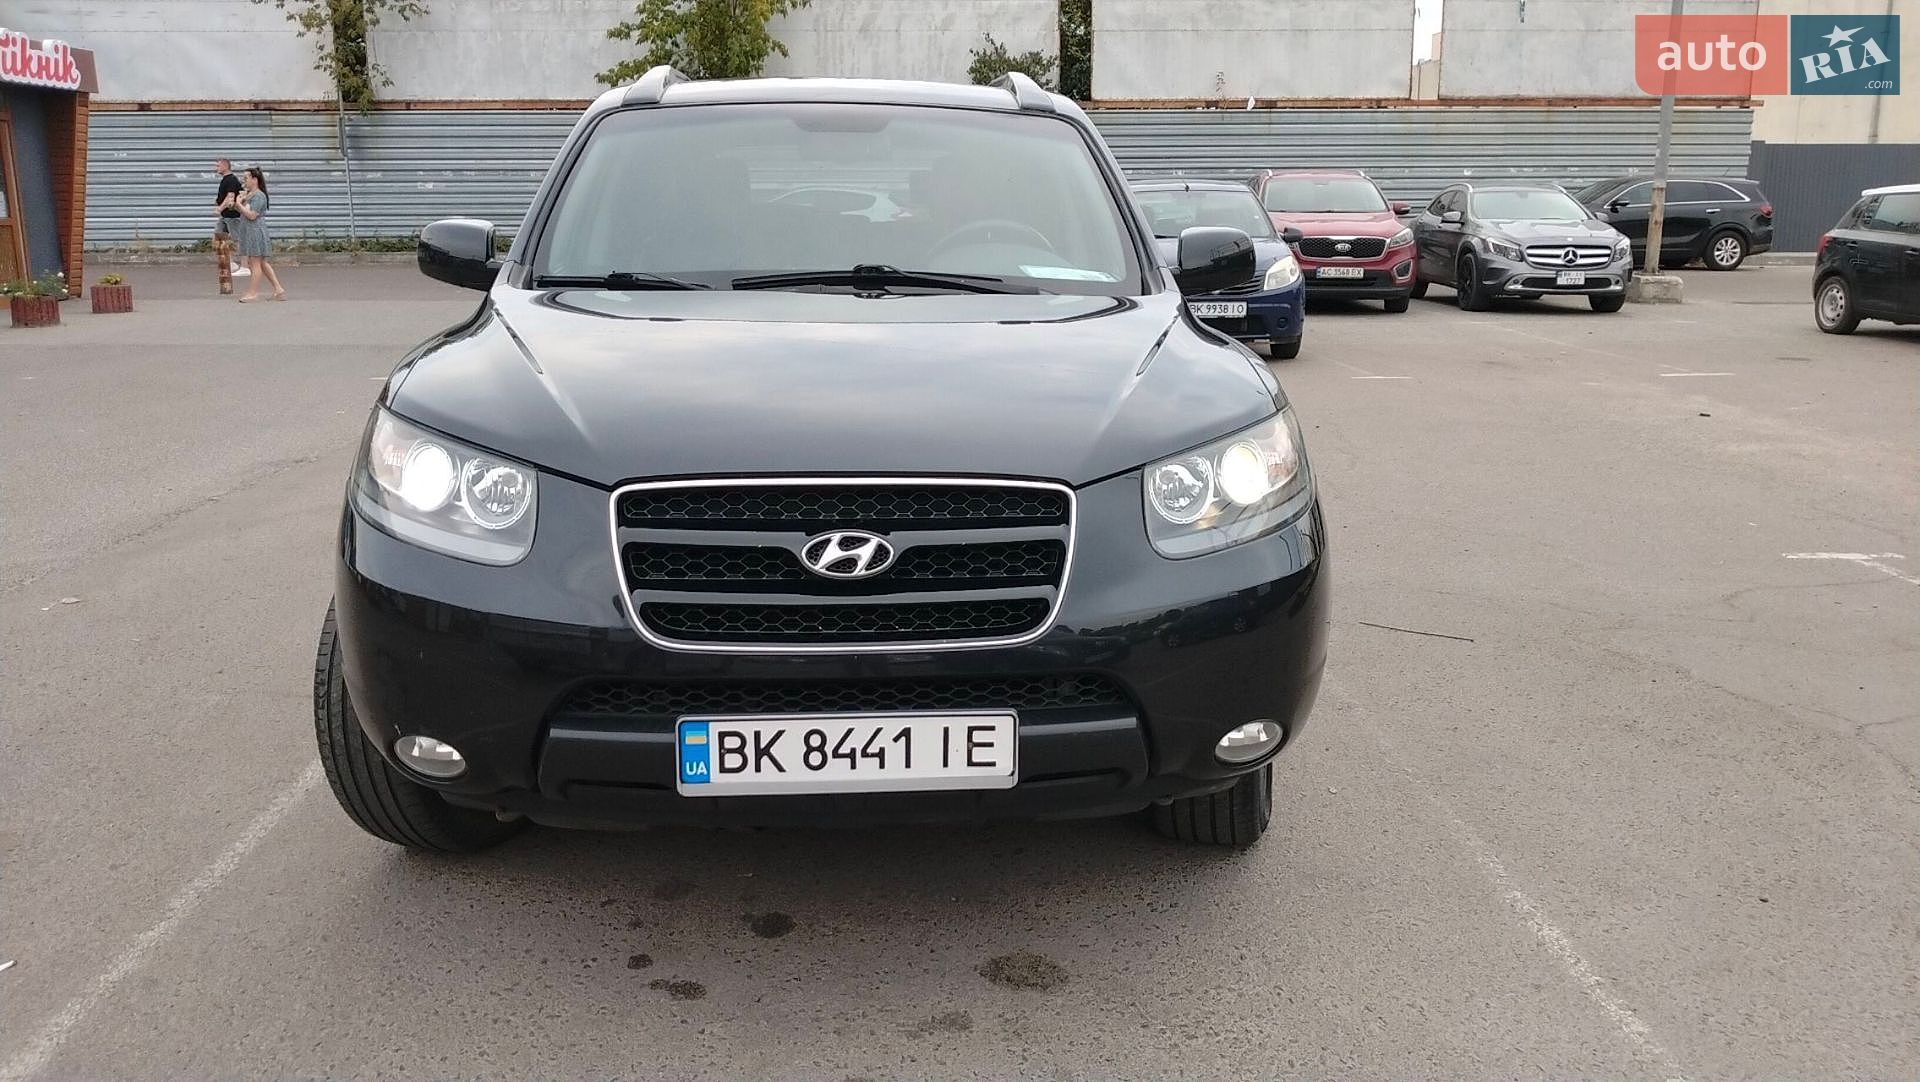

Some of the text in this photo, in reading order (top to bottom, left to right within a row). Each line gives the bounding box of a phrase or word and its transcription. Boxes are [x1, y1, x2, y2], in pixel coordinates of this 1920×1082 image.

[1206, 304, 1229, 314] 9938
[717, 725, 997, 774] BK 8441 IE
[685, 761, 708, 776] UA
